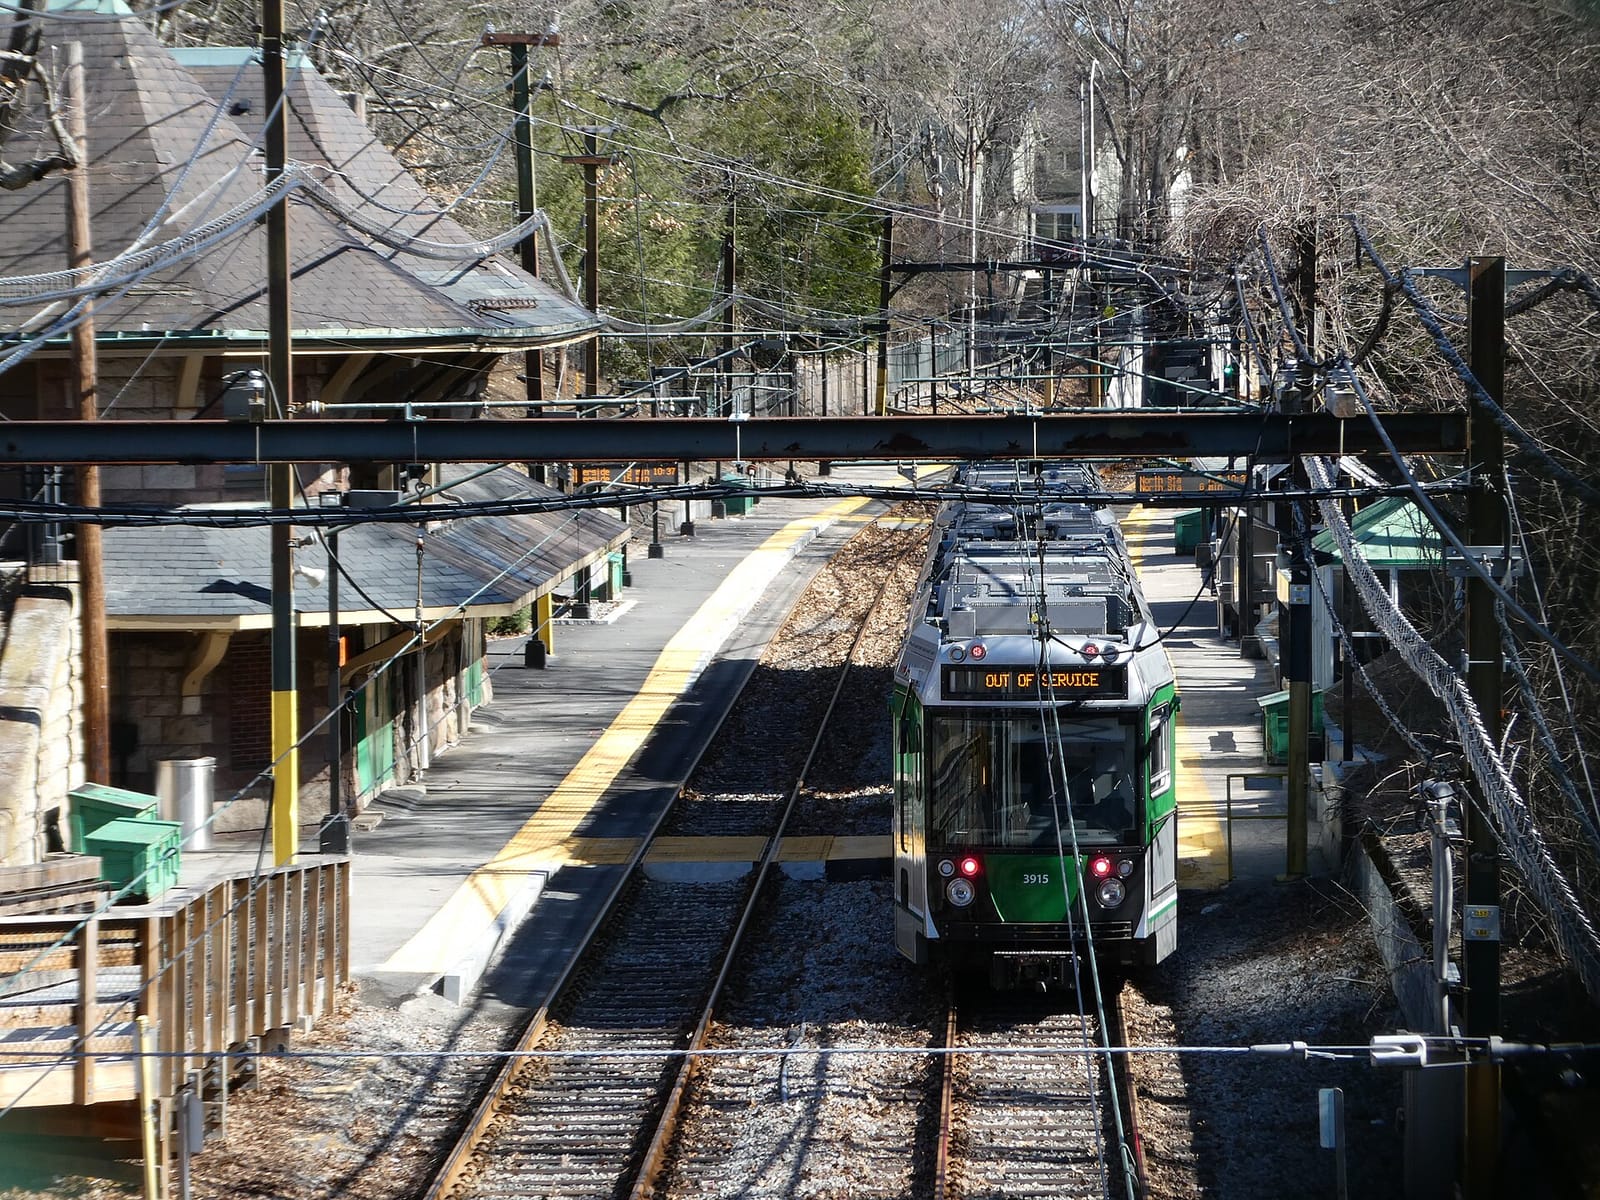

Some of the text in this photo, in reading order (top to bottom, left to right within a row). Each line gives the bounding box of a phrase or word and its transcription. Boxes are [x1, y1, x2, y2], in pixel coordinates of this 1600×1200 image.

[653, 467, 676, 475] 10:37
[1139, 475, 1182, 484] North Sta
[1227, 473, 1247, 482] 10:3
[1139, 484, 1164, 492] North
[985, 672, 1099, 688] OUT OF SERVICE
[1023, 874, 1049, 884] 3915
